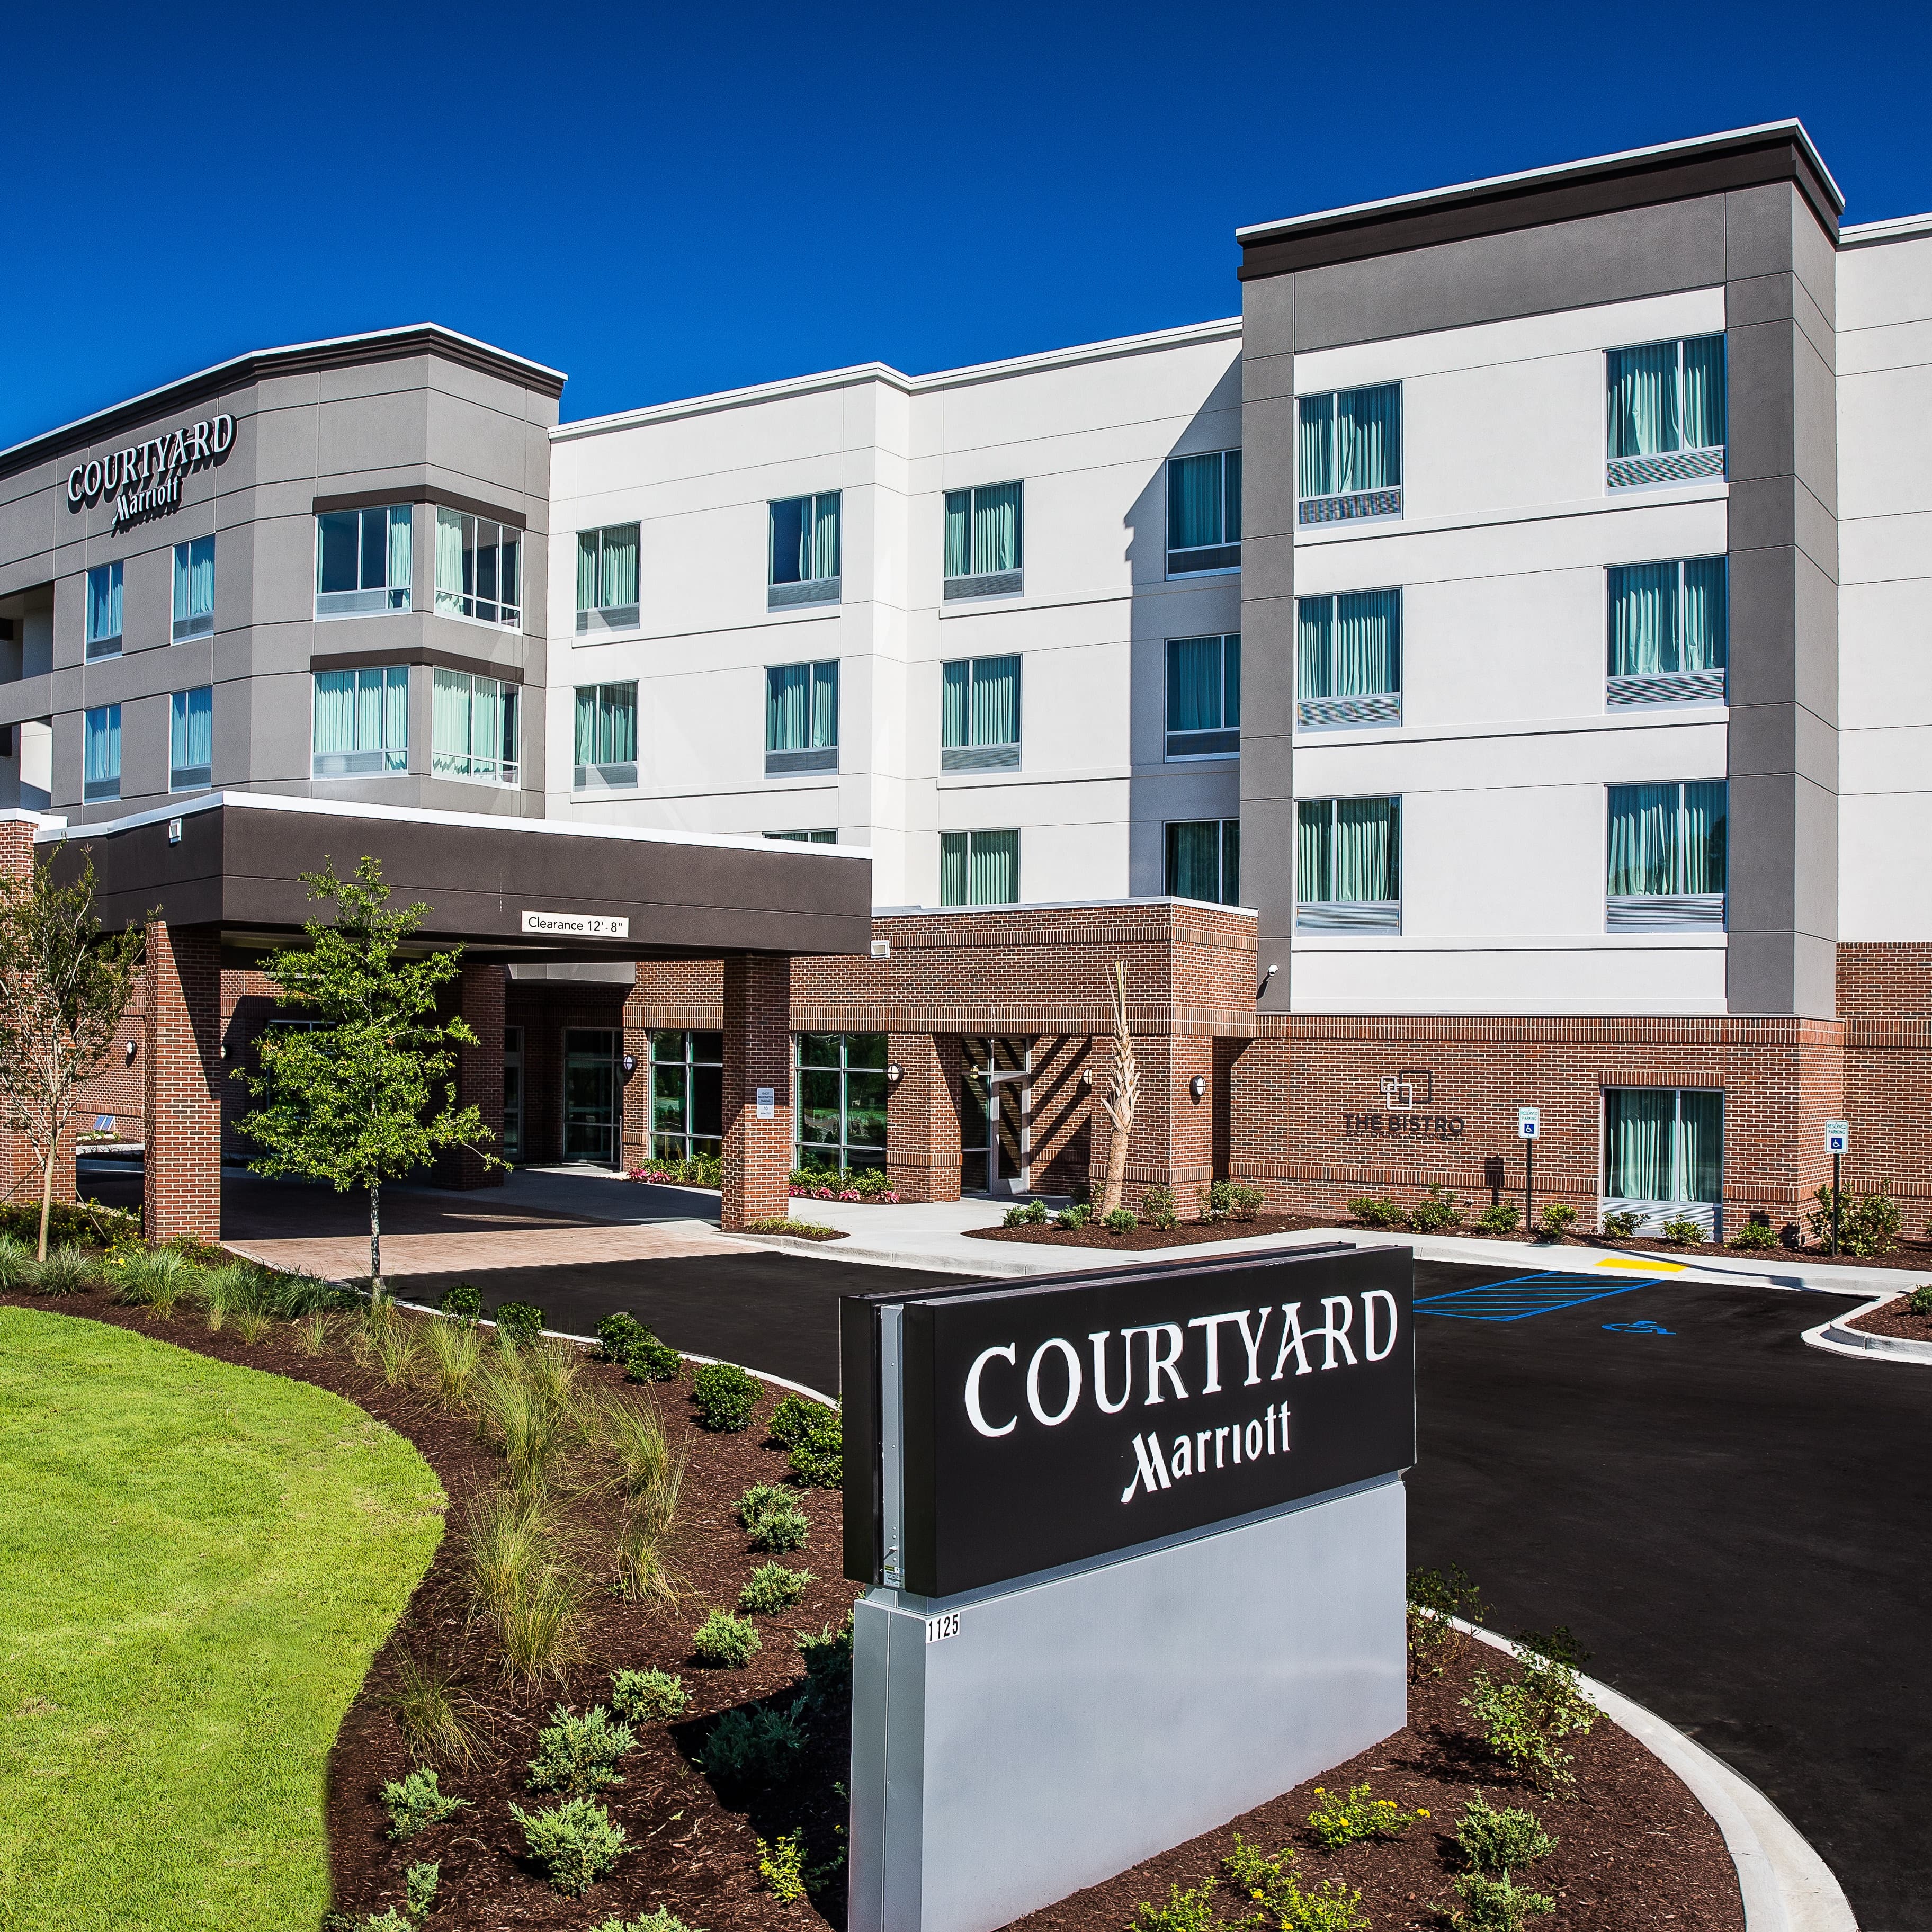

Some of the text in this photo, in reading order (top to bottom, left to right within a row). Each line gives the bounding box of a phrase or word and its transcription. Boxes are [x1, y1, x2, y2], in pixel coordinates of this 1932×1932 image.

[67, 413, 235, 502] COURTYARD
[111, 475, 180, 526] Marriott
[528, 916, 584, 931] Clearance
[1343, 1113, 1465, 1135] THE BISTRO
[965, 1289, 1398, 1437] COURTYARD
[1120, 1399, 1291, 1504] Marriott
[928, 1614, 958, 1641] 1125
